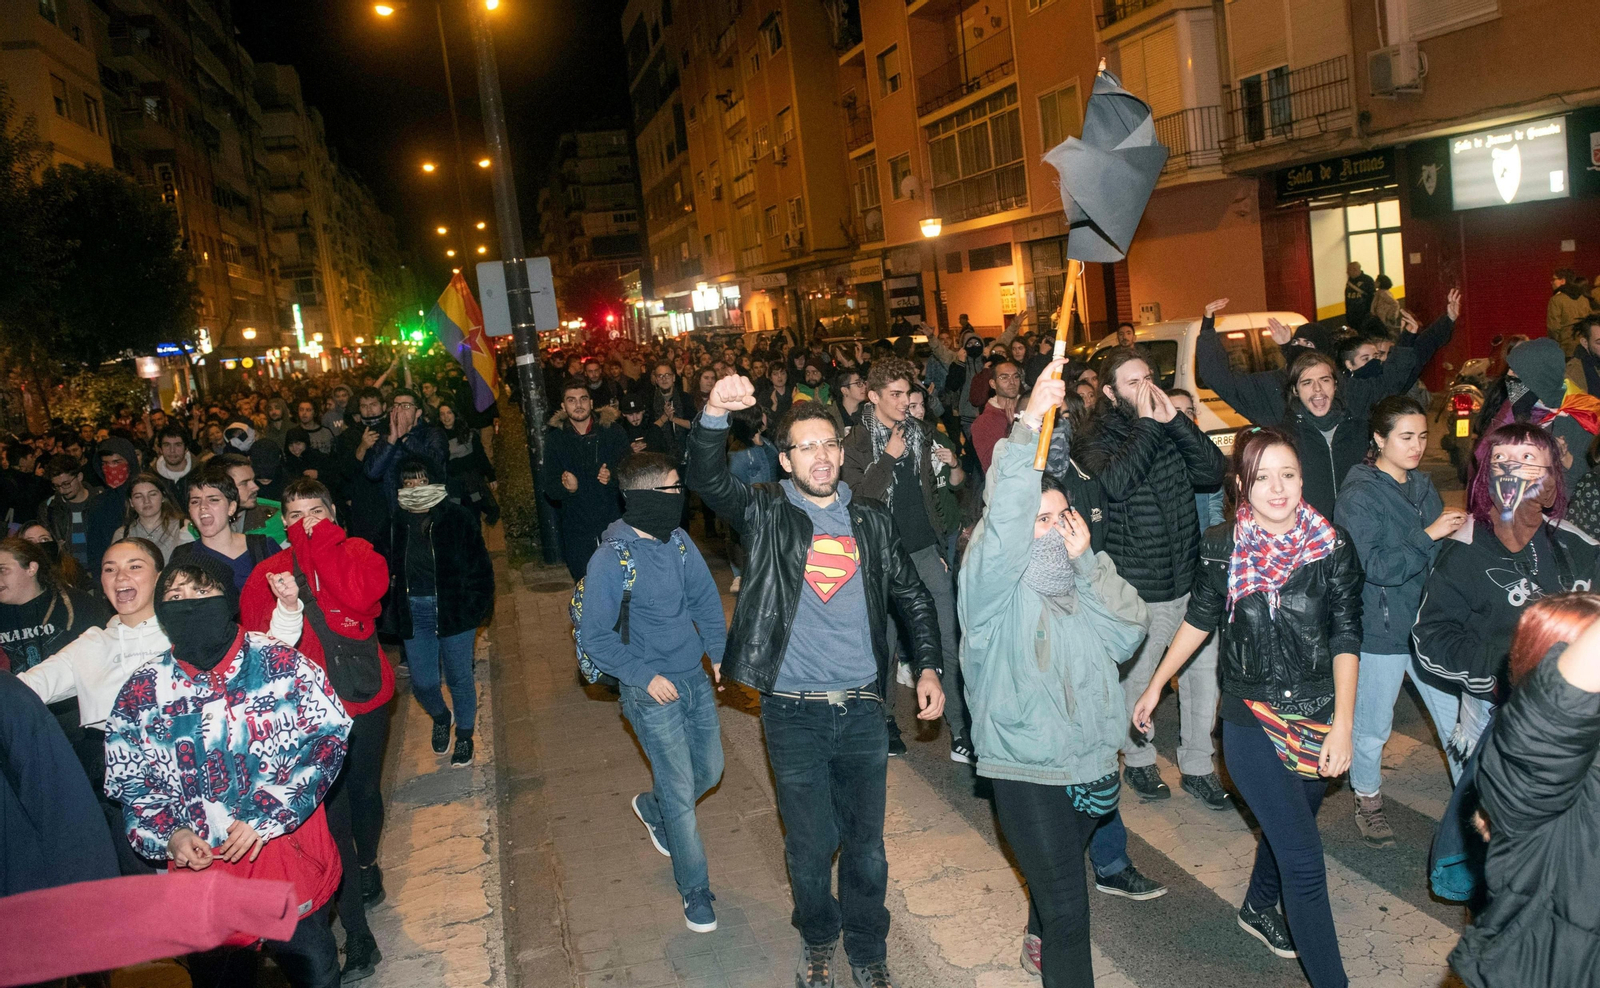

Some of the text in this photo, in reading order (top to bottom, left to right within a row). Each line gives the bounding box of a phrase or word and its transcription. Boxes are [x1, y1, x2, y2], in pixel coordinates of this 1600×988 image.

[1287, 156, 1386, 190] Sala de Armas
